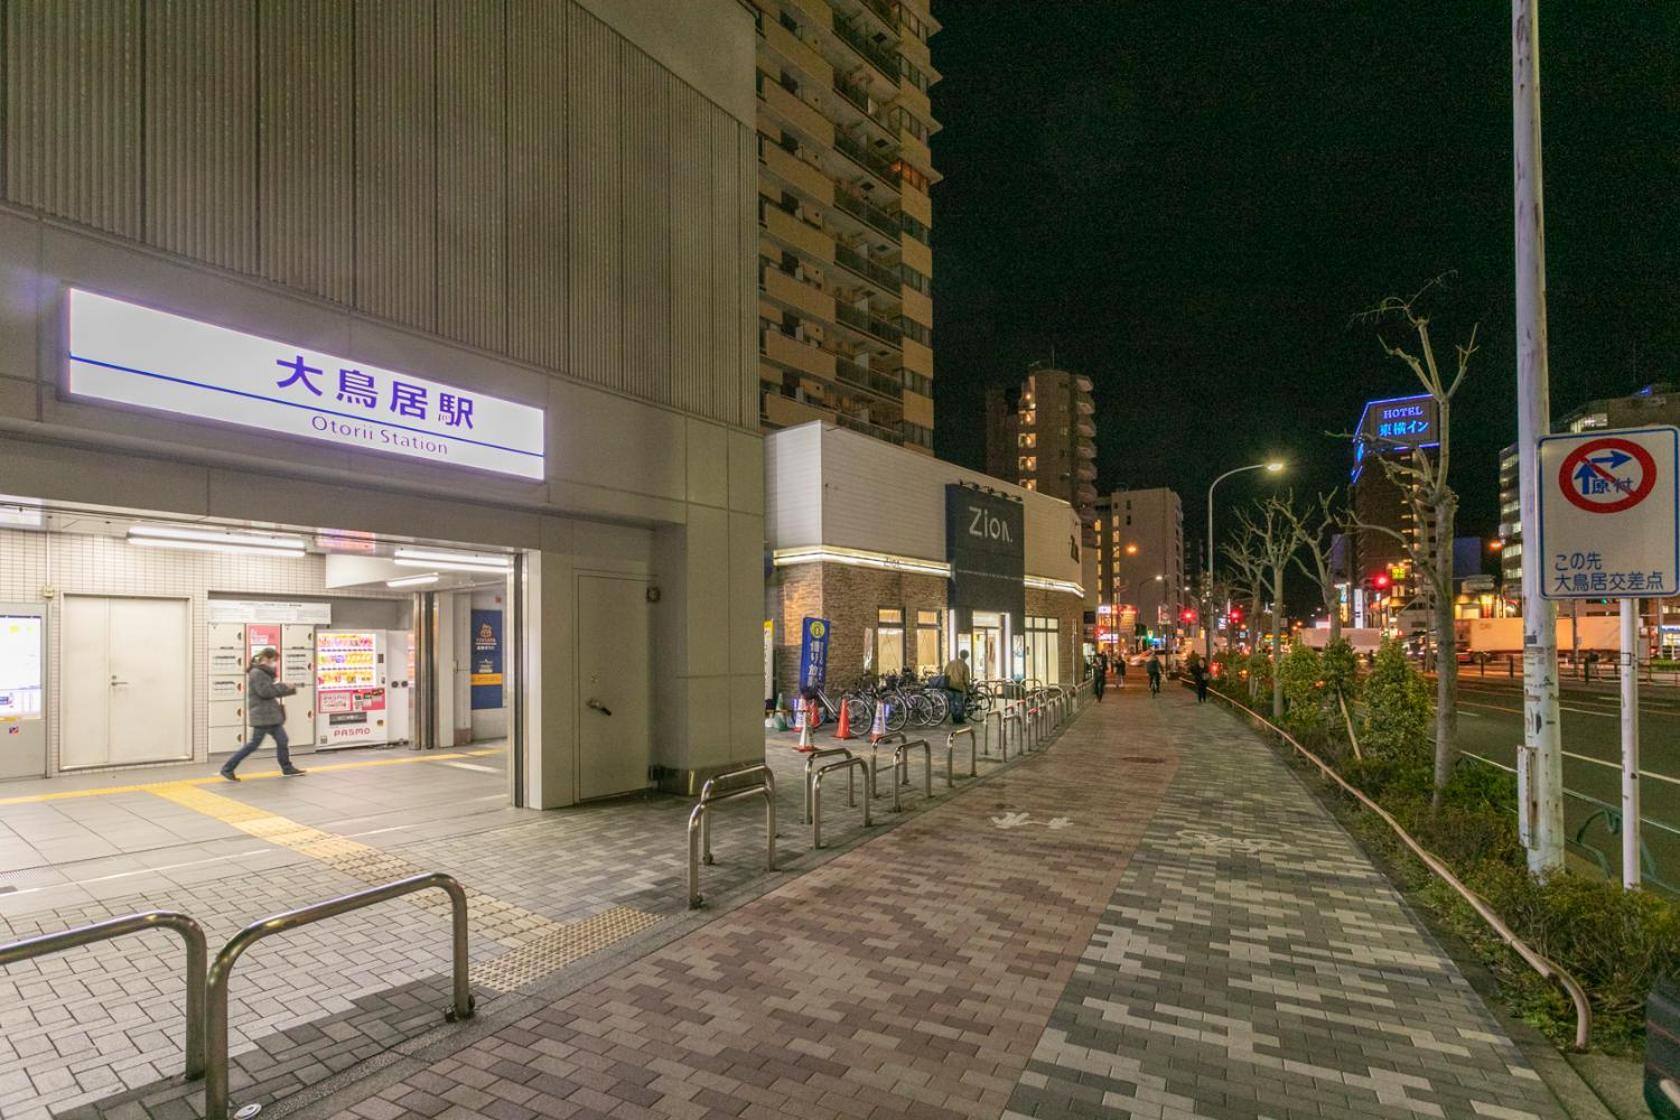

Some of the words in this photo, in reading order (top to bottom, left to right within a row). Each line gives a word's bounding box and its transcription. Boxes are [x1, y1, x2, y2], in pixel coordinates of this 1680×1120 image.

[276, 355, 474, 430] 大鳥居駅
[1383, 406, 1424, 419] HOTEL
[311, 415, 374, 440] Otorii
[380, 429, 449, 454] Station
[1379, 421, 1429, 437] 東横イン
[1591, 477, 1633, 494] 原付
[1555, 552, 1602, 571] この先
[1555, 571, 1664, 591] 大鳥居交差点
[333, 727, 371, 737] PASMO
